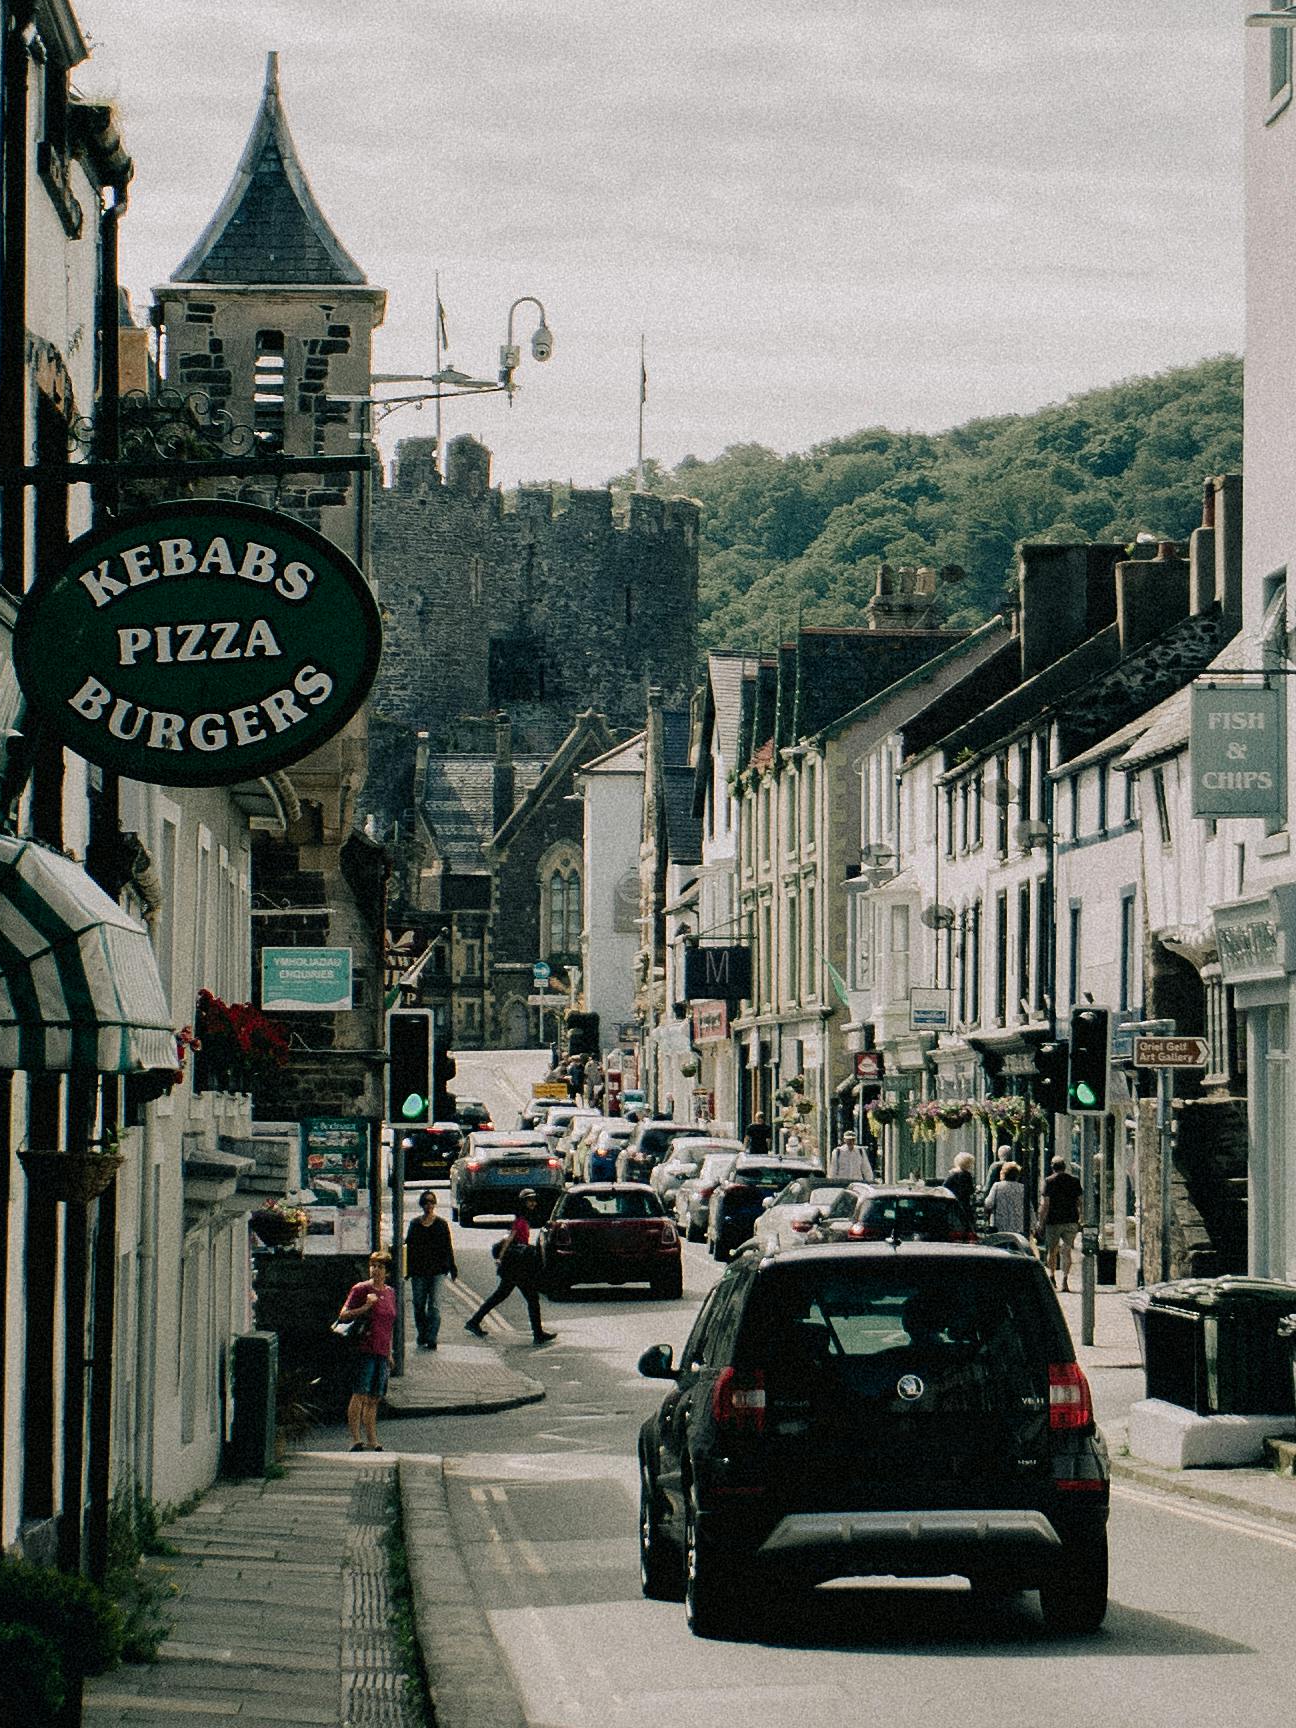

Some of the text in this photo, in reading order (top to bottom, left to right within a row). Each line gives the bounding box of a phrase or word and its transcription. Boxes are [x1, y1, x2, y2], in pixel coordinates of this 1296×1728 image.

[79, 537, 315, 607] KEBABS
[118, 619, 282, 665] PIZZA
[68, 665, 333, 751] BURGERS
[1207, 712, 1265, 730] FISH
[1226, 741, 1248, 760] &
[1201, 771, 1273, 790] CHIPS
[705, 950, 729, 985] M
[1139, 1052, 1194, 1063] Art Gallery
